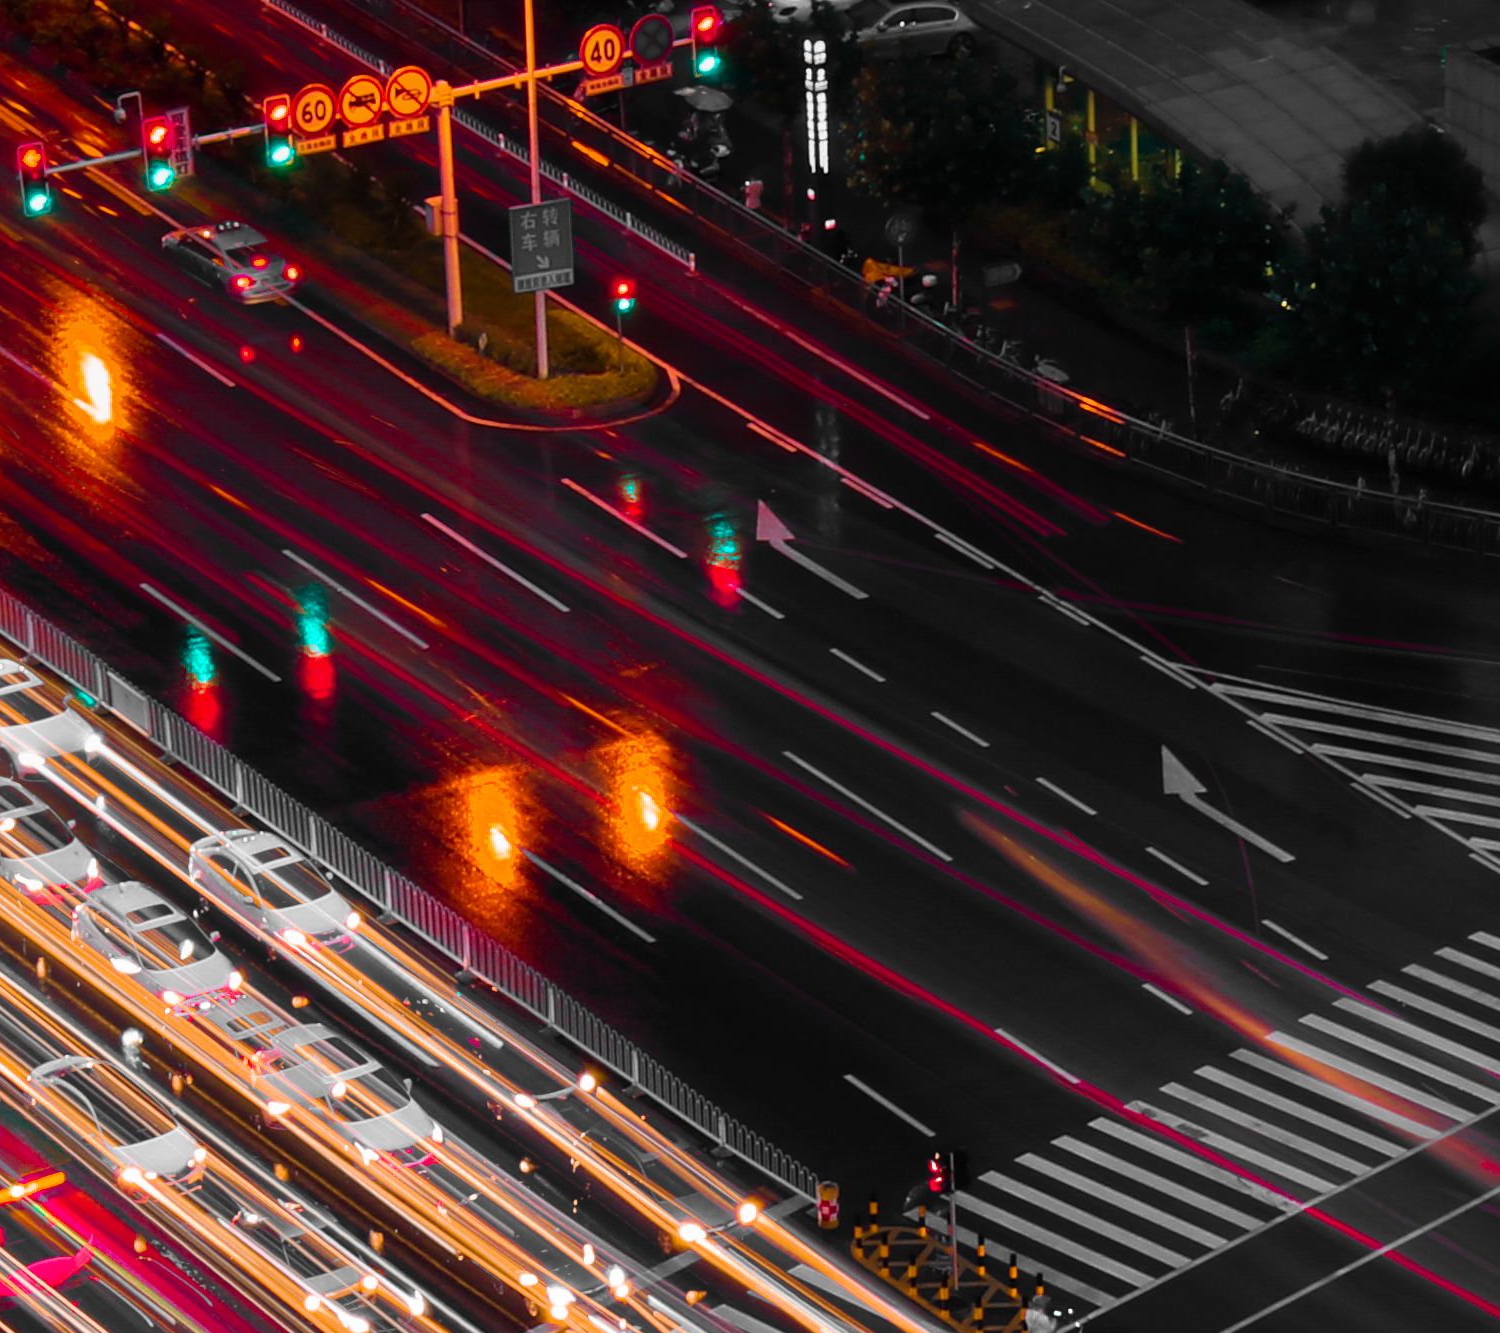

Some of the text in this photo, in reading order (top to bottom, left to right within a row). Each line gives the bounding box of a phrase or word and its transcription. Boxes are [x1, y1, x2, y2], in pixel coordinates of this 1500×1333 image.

[590, 38, 615, 63] 40
[302, 100, 326, 123] 60
[520, 207, 558, 230] 右转
